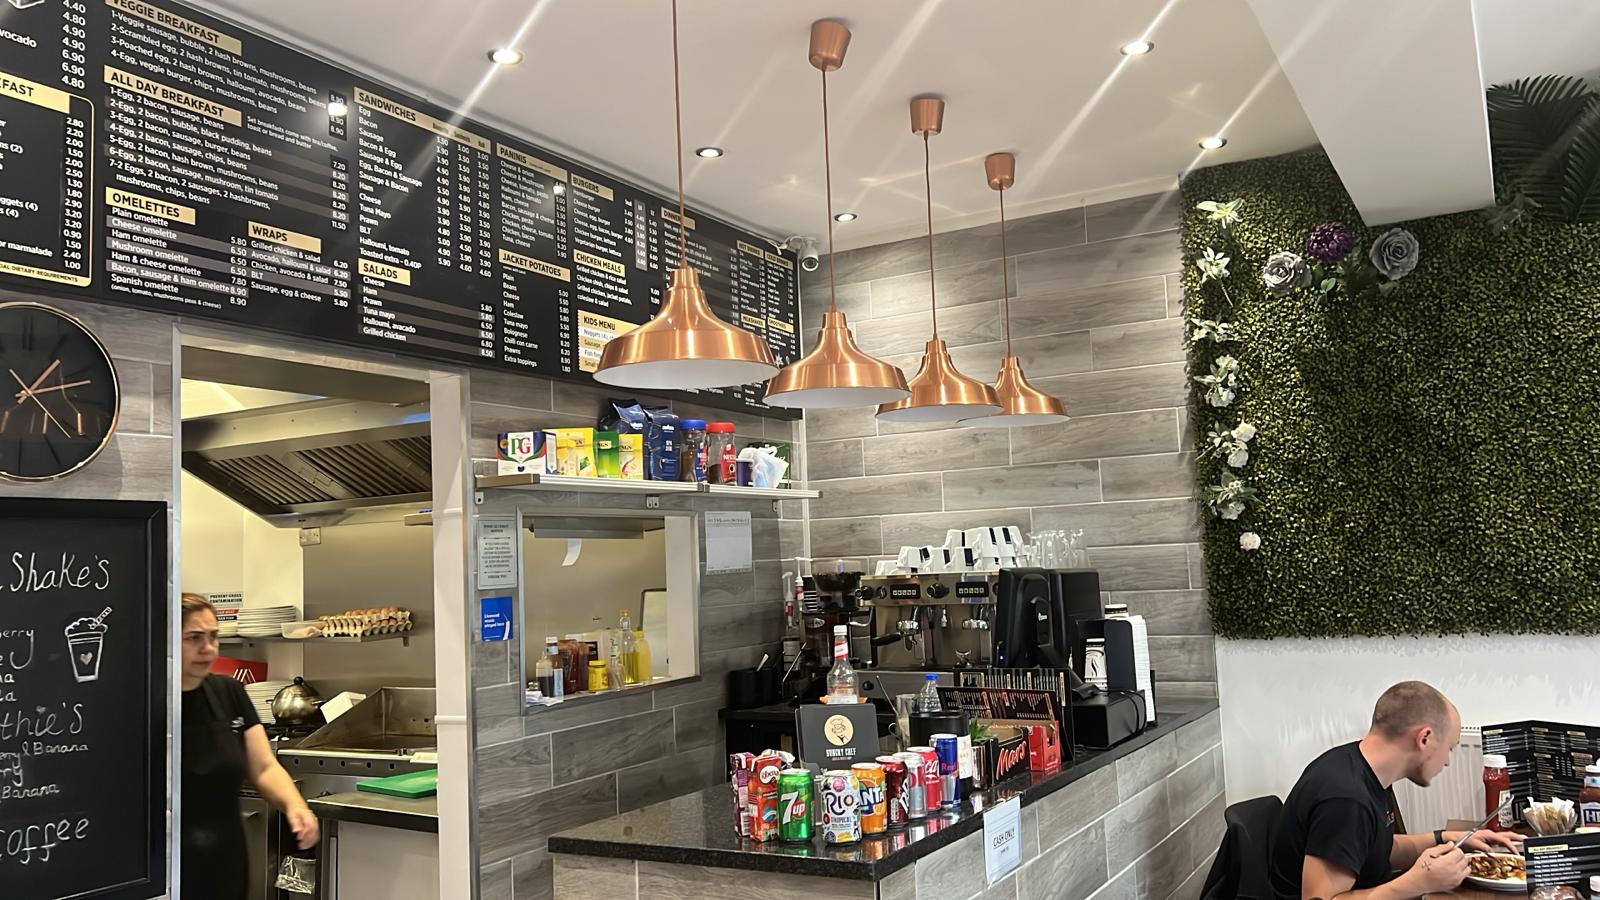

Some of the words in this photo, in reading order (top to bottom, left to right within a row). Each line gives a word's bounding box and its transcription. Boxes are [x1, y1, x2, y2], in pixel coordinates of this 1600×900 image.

[63, 0, 86, 13] 4.40
[63, 12, 86, 26] 4.80
[62, 24, 85, 38] 4.90
[158, 12, 219, 44] BREAKFAST
[62, 37, 85, 51] 4.90
[62, 50, 85, 64] 6.90
[112, 10, 144, 28] 1-Veggie
[147, 25, 178, 42] sausage,
[180, 36, 207, 53] bubble,
[215, 50, 231, 61] hash
[232, 56, 258, 72] browns,
[260, 68, 297, 88] mushrooms,
[299, 82, 317, 94] beans
[62, 62, 84, 76] 6.90
[0, 78, 34, 96] FAST
[62, 76, 84, 89] 4.80
[111, 49, 138, 65] 4-Egg,
[139, 60, 165, 74] veggie
[166, 68, 193, 84] burger,
[194, 78, 215, 92] chips,
[216, 87, 257, 107] mushrooms,
[258, 101, 278, 114] beans
[111, 72, 133, 87] ALL
[136, 80, 158, 95] DAY
[162, 89, 224, 117] BREAKFAST
[110, 87, 134, 102] 1-Egg,
[144, 98, 169, 112] bacon,
[170, 108, 202, 123] sausage,
[204, 117, 224, 130] beans
[359, 92, 416, 122] SANDWICHES
[359, 106, 371, 117] Egg
[66, 118, 84, 128] 2.80
[359, 117, 378, 129] Bacon
[66, 128, 84, 138] 2.20
[359, 128, 384, 142] Sausage
[66, 138, 84, 148] 2.00
[68, 148, 83, 158] 1.50
[500, 147, 527, 164] PANINIS
[110, 135, 136, 150] 5-Egg,
[145, 145, 170, 159] bacon,
[172, 153, 189, 164] hash
[191, 158, 215, 172] brown,
[217, 167, 258, 185] mushrooms,
[259, 178, 278, 190] beans
[110, 159, 123, 170] 7-2
[124, 163, 146, 176] Eggs,
[154, 171, 180, 185] bacon,
[188, 182, 222, 197] sausages,
[230, 192, 271, 210] hashbrowns,
[116, 174, 164, 192] mushrooms,
[166, 188, 187, 199] chips,
[188, 193, 210, 204] beans
[360, 182, 374, 192] Ham
[573, 176, 599, 193] BURGERS
[112, 193, 180, 218] OMELETTES
[360, 203, 374, 213] Tuna
[375, 208, 392, 219] Mayo
[65, 208, 82, 219] 3.20
[112, 206, 132, 219] Plain
[133, 214, 169, 227] omelette
[112, 218, 141, 232] Cheese
[142, 224, 177, 240] omelette
[252, 225, 288, 242] WRAPS
[112, 229, 131, 240] Ham
[132, 235, 168, 249] omelette
[230, 236, 246, 247] 5.80
[360, 237, 388, 250] Halloumi,
[388, 244, 410, 256] tomato
[8, 242, 53, 257] marmalade
[112, 240, 154, 256] Mushroom
[155, 250, 189, 264] omelette
[230, 246, 246, 257] 6.50
[251, 240, 272, 252] Grilled
[274, 247, 297, 258] chicken
[304, 253, 320, 263] salad
[360, 248, 383, 260] Toasted
[384, 255, 399, 264] extra
[230, 257, 246, 266] 6.50
[502, 252, 528, 266] JACKET
[529, 261, 561, 277] POTATOES
[576, 252, 601, 267] CHICKEN
[602, 261, 621, 273] MEALS
[230, 267, 246, 276] 6.50
[251, 271, 263, 280] BLT
[363, 263, 398, 279] SALADS
[111, 273, 143, 287] Spanish
[144, 280, 179, 294] omelette
[231, 277, 246, 286] 7.80
[363, 277, 385, 288] Cheese
[230, 286, 246, 296] 8.90
[251, 281, 279, 294] Sausage,
[280, 288, 293, 297] egg
[300, 292, 321, 302] cheese
[230, 296, 246, 306] 8.90
[584, 316, 598, 326] KIDS
[599, 320, 616, 331] MENU
[363, 327, 383, 337] Grilled
[384, 332, 407, 342] chicken
[511, 438, 531, 455] PG
[33, 742, 88, 755] Banana
[996, 741, 1027, 780] Mars
[2, 784, 60, 798] Banana
[781, 791, 799, 825] 7
[993, 833, 1004, 847] CASH
